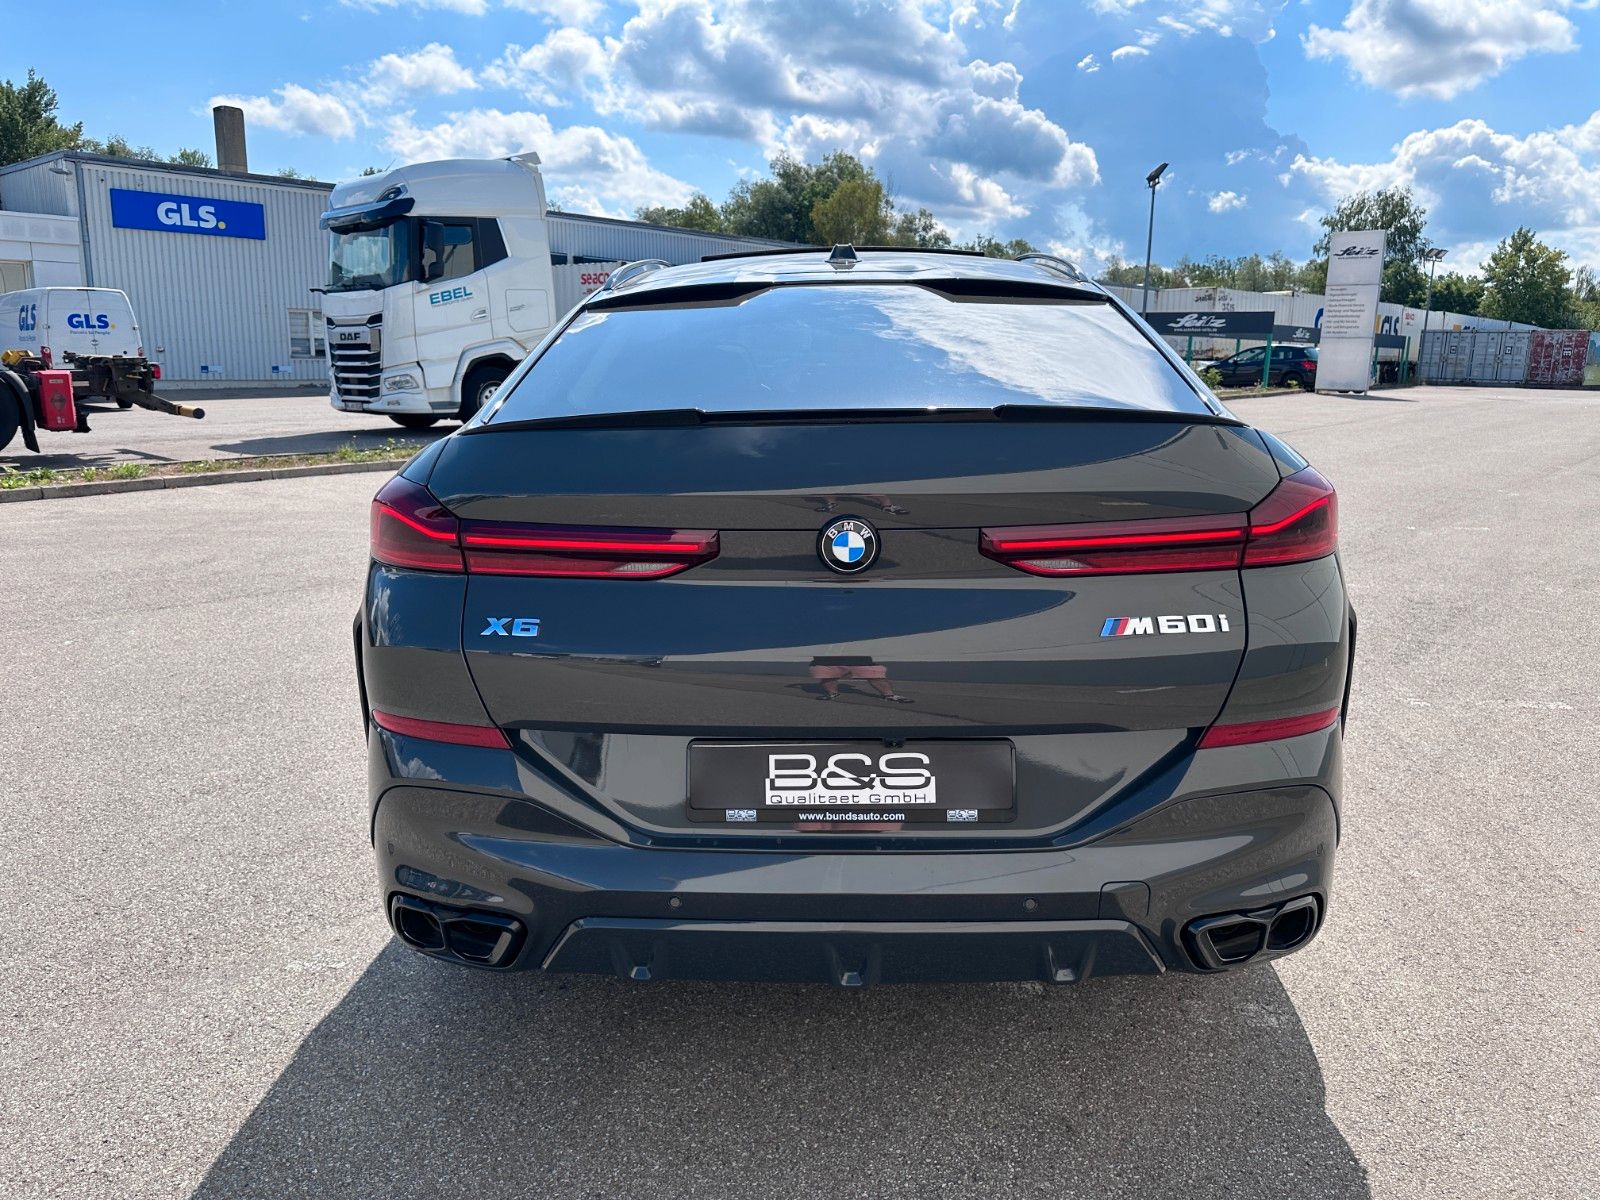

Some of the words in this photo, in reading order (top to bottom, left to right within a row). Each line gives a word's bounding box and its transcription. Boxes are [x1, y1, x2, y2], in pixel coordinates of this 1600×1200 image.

[429, 286, 473, 305] EBEL
[19, 303, 37, 332] GLS
[339, 332, 361, 341] DAF
[827, 520, 872, 540] BMW
[480, 616, 541, 637] X6
[767, 752, 932, 791] B&S
[769, 792, 860, 805] Qualitaet
[798, 811, 905, 822] www.bundsauto.com
